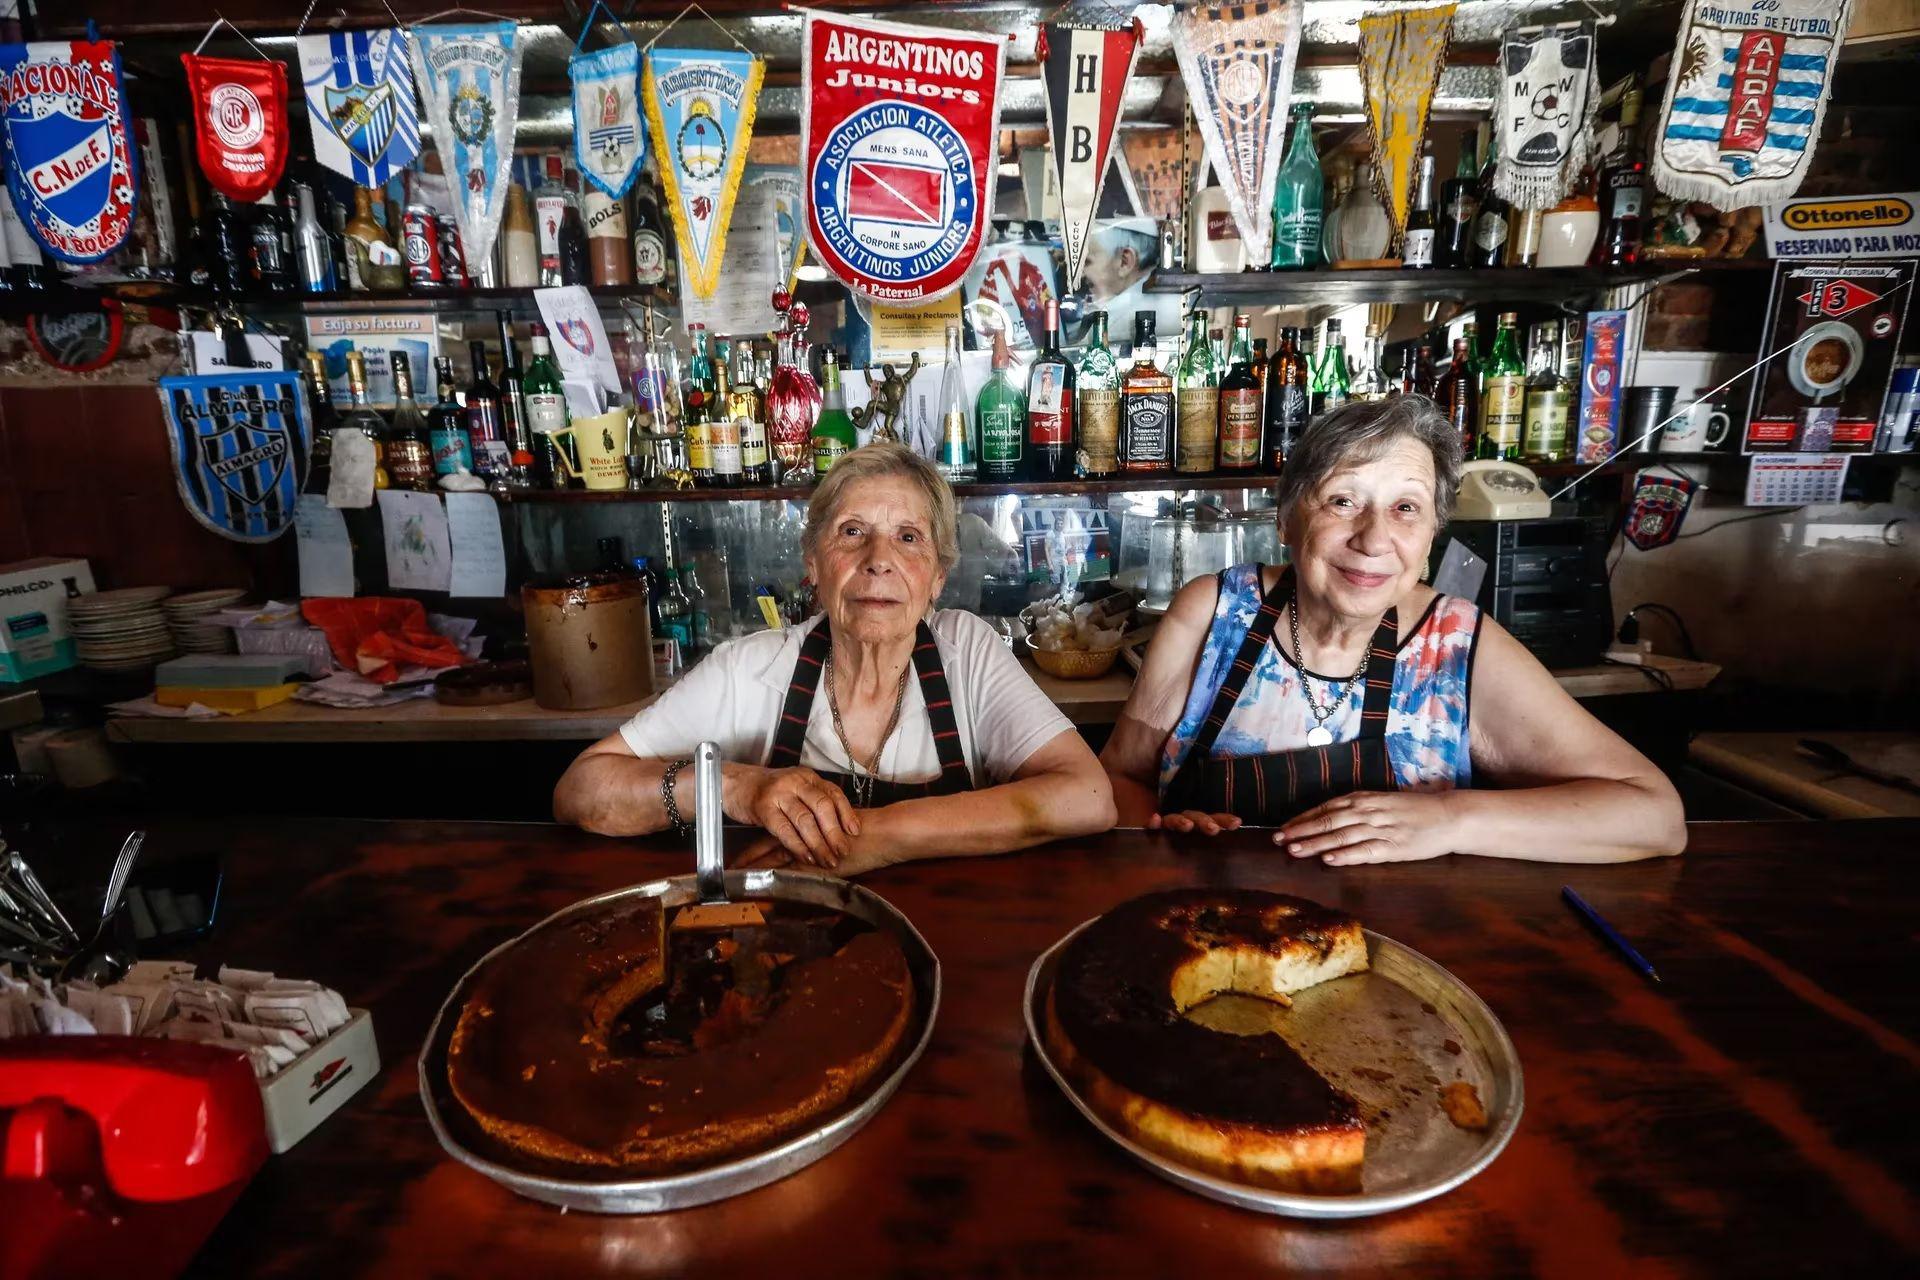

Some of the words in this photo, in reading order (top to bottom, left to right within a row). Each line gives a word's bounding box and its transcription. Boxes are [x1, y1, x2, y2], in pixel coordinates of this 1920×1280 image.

[1751, 0, 1781, 12] de
[1699, 5, 1760, 26] ARBITROS
[1764, 16, 1779, 28] DE
[1781, 17, 1832, 36] FUTBOL
[824, 29, 985, 81] ARGENTINOS
[660, 67, 745, 102] ARGENTINA
[1074, 54, 1098, 94] H
[0, 64, 119, 115] NACIONAL
[825, 68, 980, 105] Juniors
[825, 107, 909, 171] ASOCIACION
[914, 115, 969, 186] ATLETICA
[870, 143, 898, 155] MENS
[902, 147, 929, 159] SANA
[1070, 125, 1092, 164] B
[589, 202, 622, 230] BOLS
[1791, 205, 1904, 225] Ottonello
[820, 205, 902, 278] ARGENTINOS
[909, 219, 968, 275] JUNIORS
[859, 233, 900, 251] CORPORE
[902, 239, 927, 251] SANO
[890, 230, 901, 239] IN
[1775, 237, 1851, 256] RESERVADO
[1854, 235, 1889, 254] PARA
[852, 278, 867, 295] La
[869, 283, 924, 299] Paternal
[1827, 285, 1849, 312] 3
[323, 318, 353, 334] Exija
[354, 320, 369, 330] su
[371, 317, 420, 331] factura
[880, 312, 915, 321] Consultas
[923, 312, 958, 321] Reclamos
[220, 391, 249, 402] Club
[180, 398, 299, 422] ALMAGRO
[1127, 402, 1144, 416] JACK
[215, 440, 284, 475] ALMAGRO
[589, 457, 612, 470] White
[0, 580, 49, 597] PHILCO
